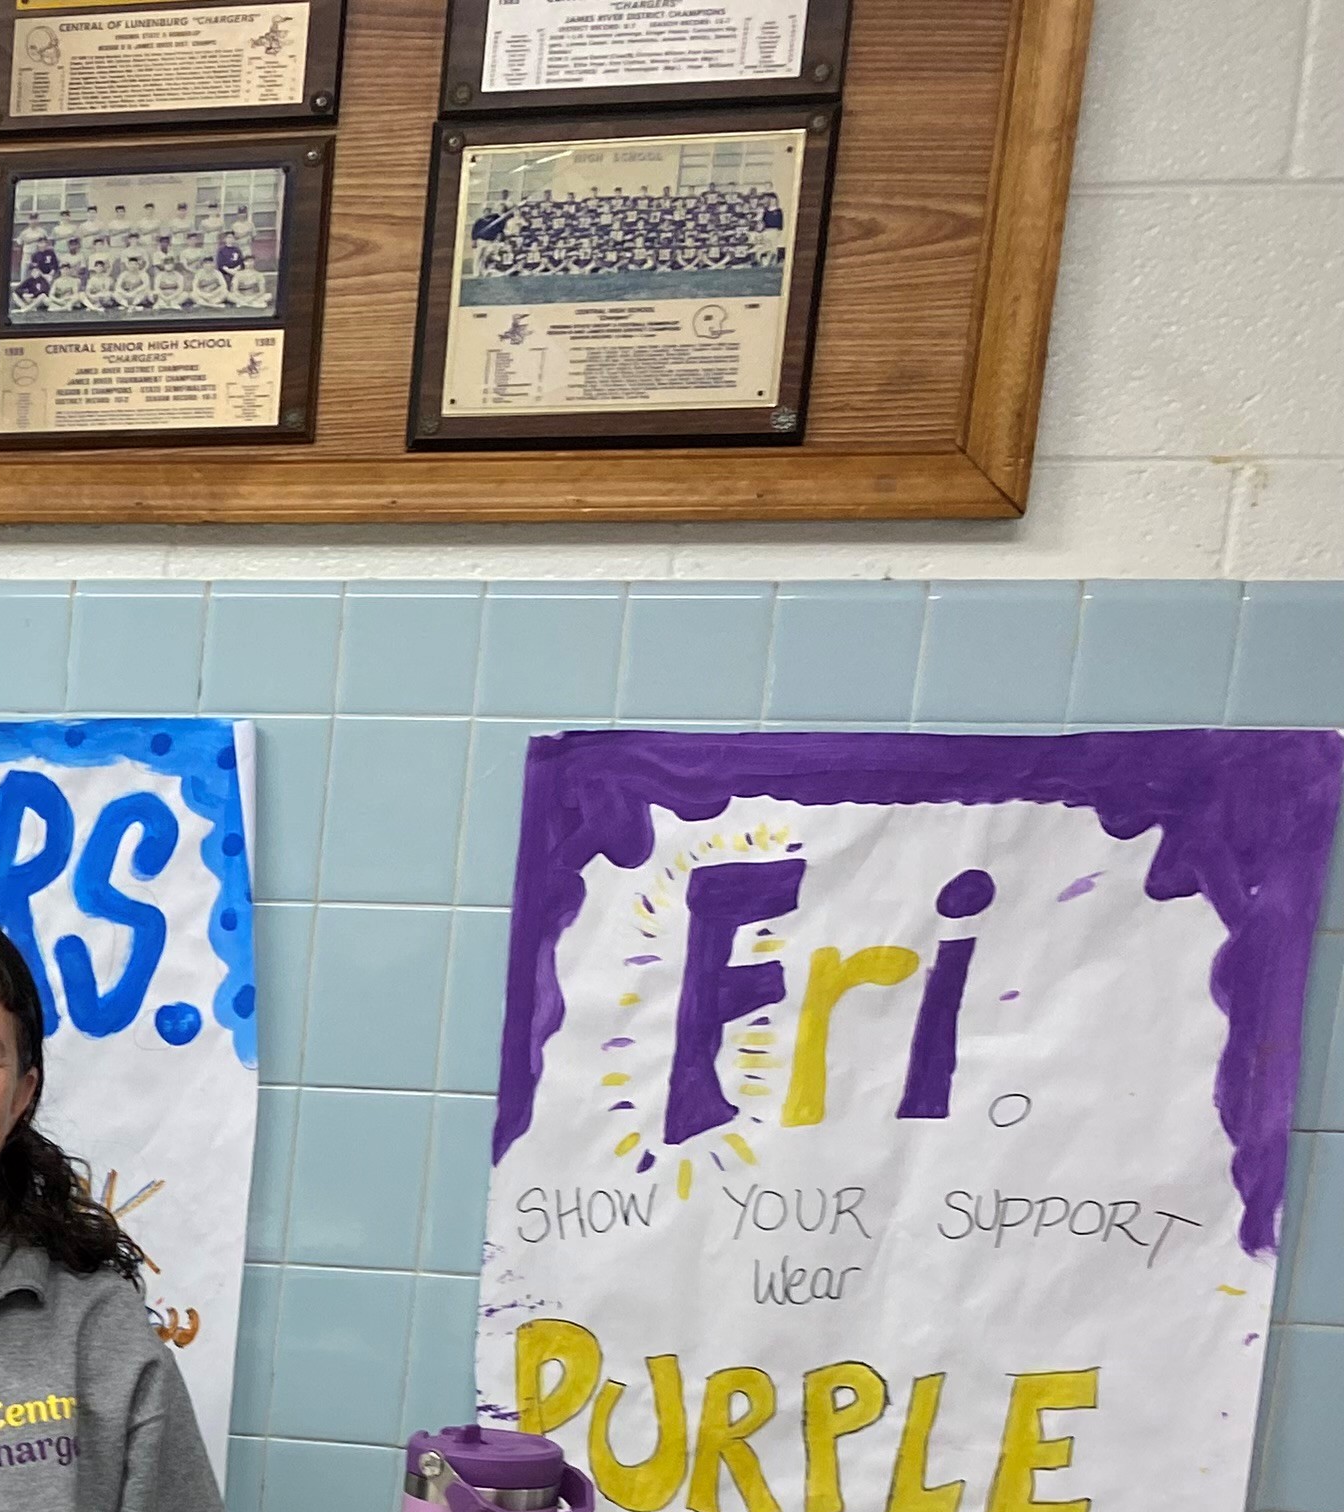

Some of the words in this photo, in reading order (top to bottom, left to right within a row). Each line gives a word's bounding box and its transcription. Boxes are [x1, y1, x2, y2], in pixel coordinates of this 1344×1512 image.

[58, 20, 104, 32] CENTRAL
[107, 19, 122, 30] OF
[124, 17, 188, 30] LUNENBURG
[45, 343, 96, 355] CENTRAL
[101, 342, 143, 353] SENIOR
[148, 340, 179, 351] HIGH
[183, 337, 233, 349] SCHOOL
[518, 1188, 655, 1245] SHOW
[723, 1183, 871, 1242] YOUR
[938, 1189, 1204, 1267] SUPPORT
